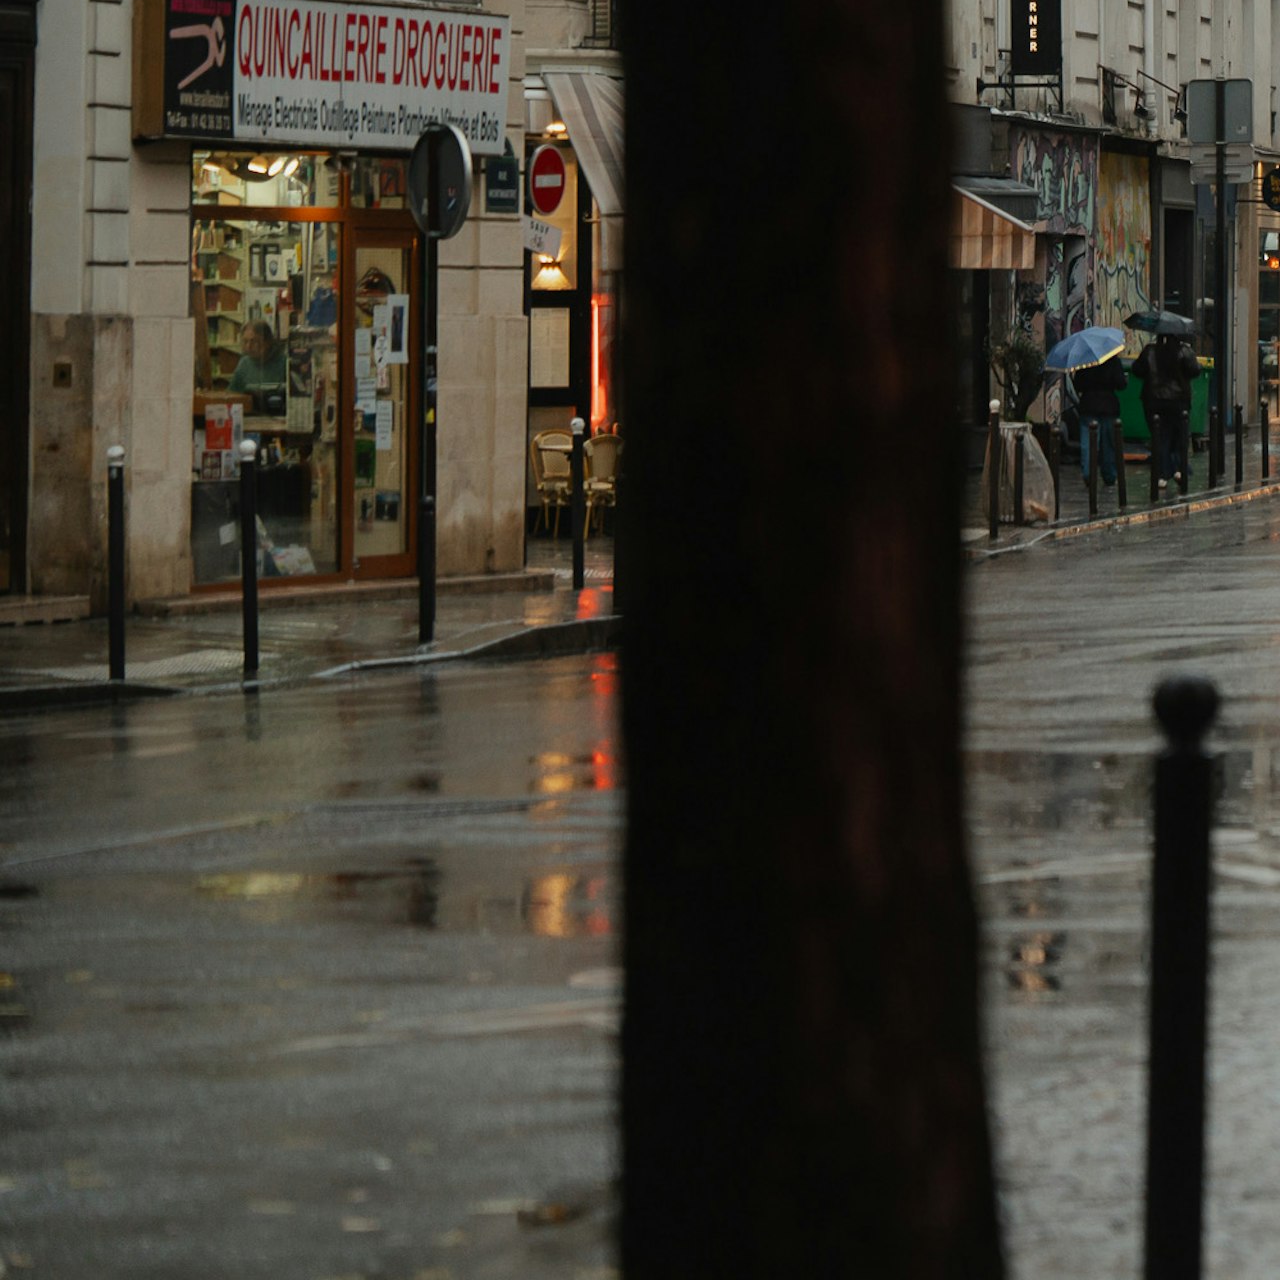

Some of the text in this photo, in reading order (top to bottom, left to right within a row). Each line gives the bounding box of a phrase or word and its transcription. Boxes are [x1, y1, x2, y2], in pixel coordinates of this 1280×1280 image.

[237, 4, 502, 94] QUINCAILLERIE DROGUERIE
[237, 93, 272, 137] Ménage
[274, 96, 318, 131] Electricité
[320, 99, 360, 141] Outillage
[361, 101, 397, 134] Peinture
[470, 112, 480, 141] et
[480, 111, 500, 142] Bois
[529, 220, 549, 235] SAUF
